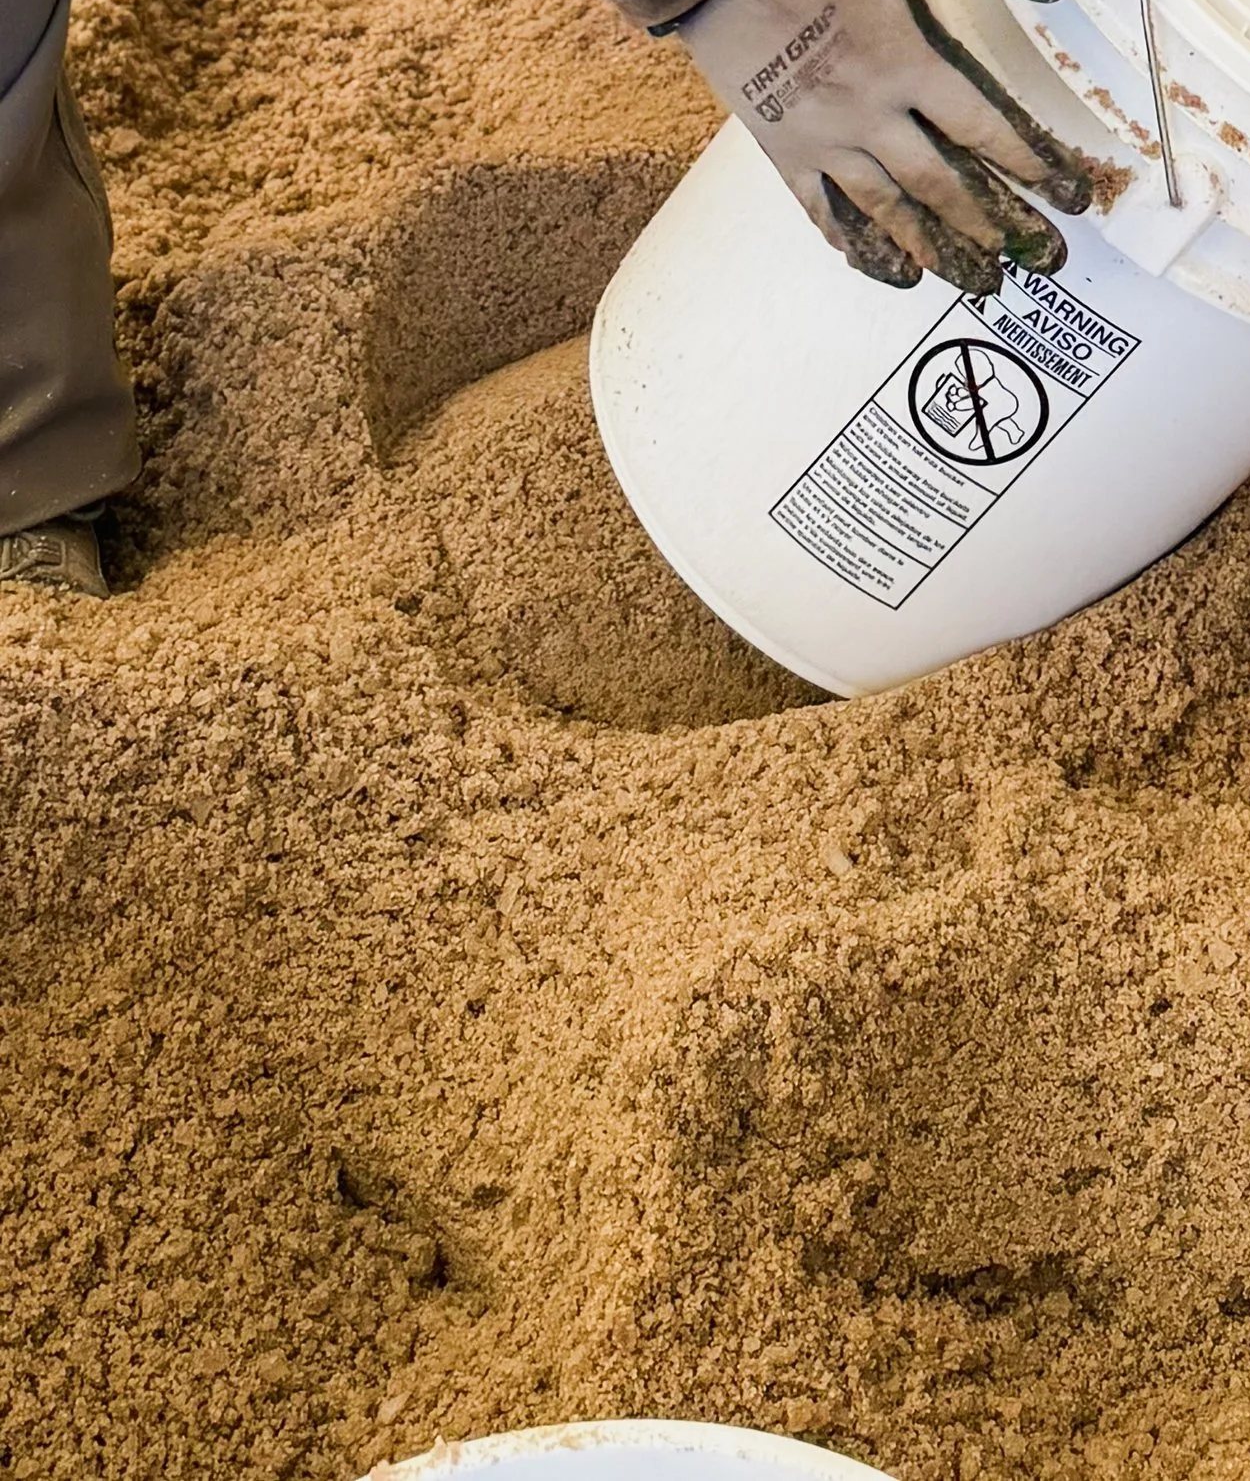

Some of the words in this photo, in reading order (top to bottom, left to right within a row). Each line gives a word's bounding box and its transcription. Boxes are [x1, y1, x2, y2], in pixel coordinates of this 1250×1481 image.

[741, 53, 788, 101] FIRM
[785, 3, 836, 61] GRIP
[992, 314, 1093, 388] AVERTISSEMENT
[1022, 309, 1093, 361] AVISO
[1023, 272, 1129, 356] WARNING
